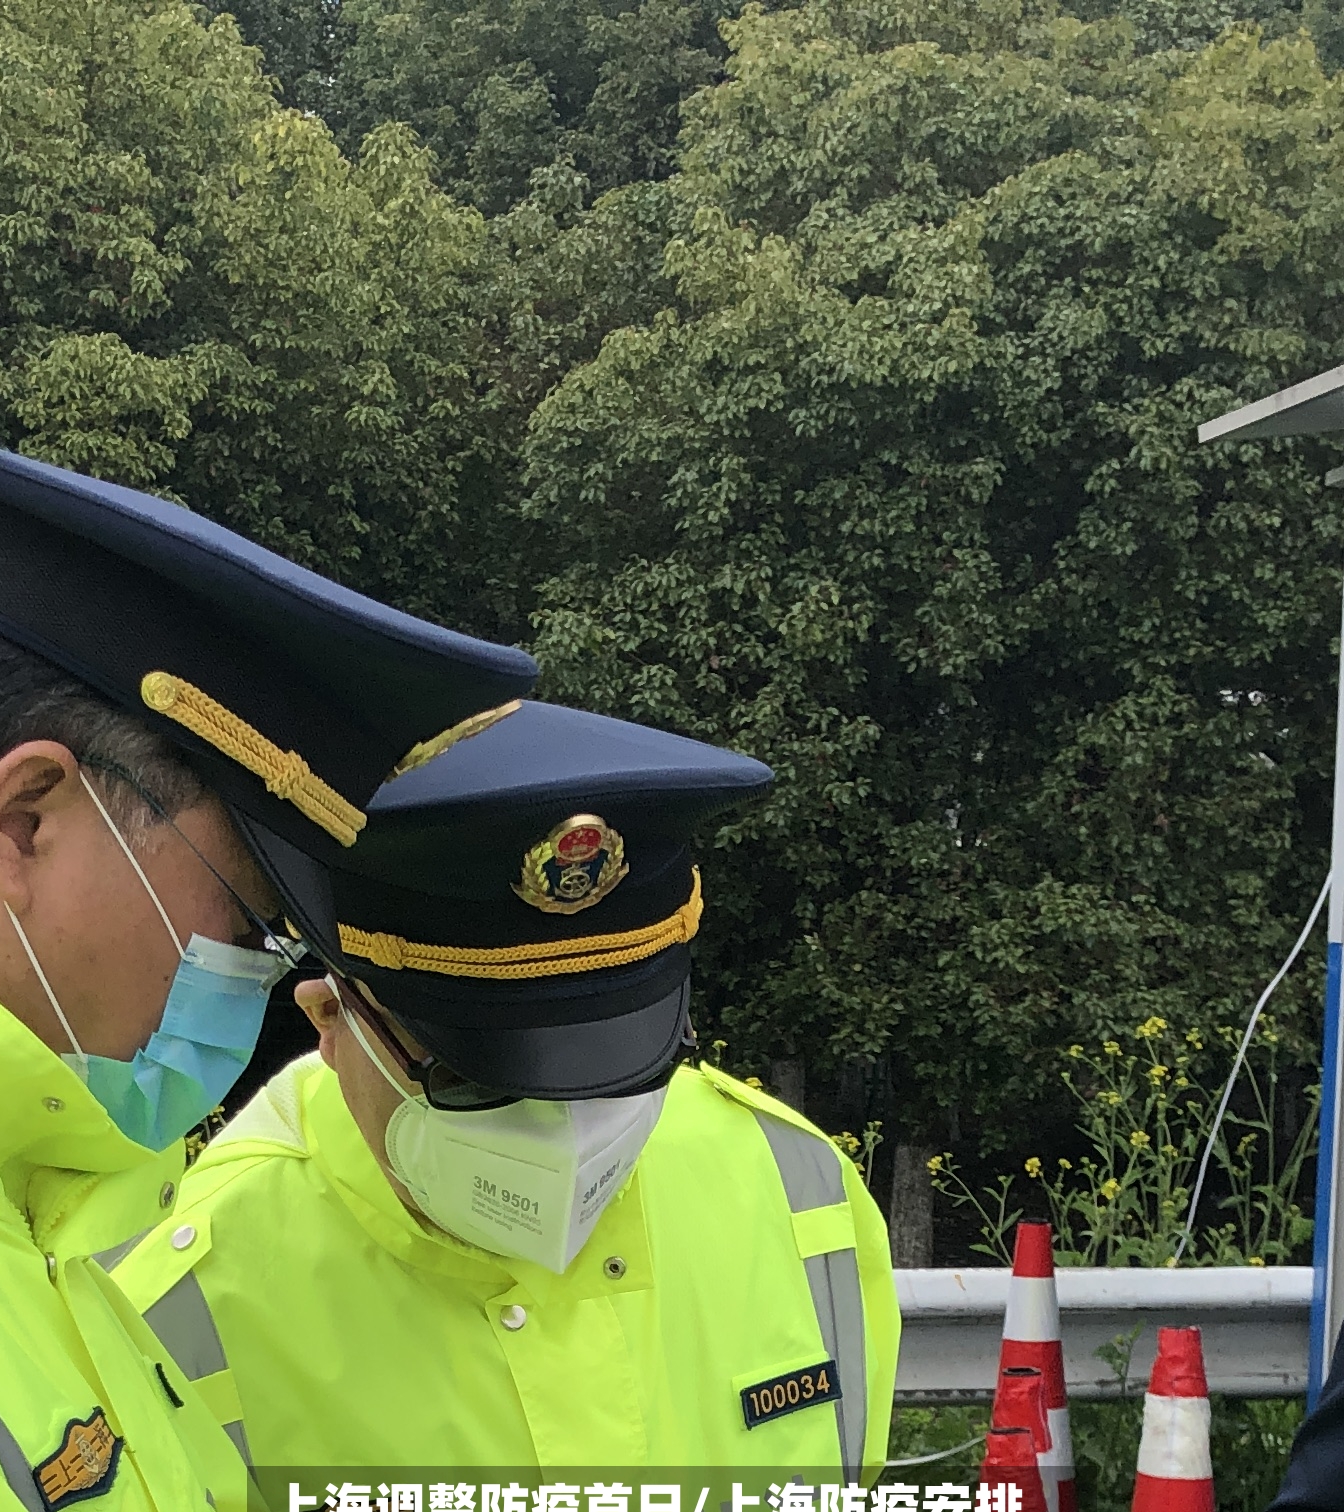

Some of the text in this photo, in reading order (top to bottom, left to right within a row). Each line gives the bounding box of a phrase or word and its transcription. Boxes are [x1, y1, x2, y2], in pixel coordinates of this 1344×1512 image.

[473, 1175, 497, 1198] 3M
[501, 1189, 539, 1216] 9501
[749, 1369, 831, 1417] 100034
